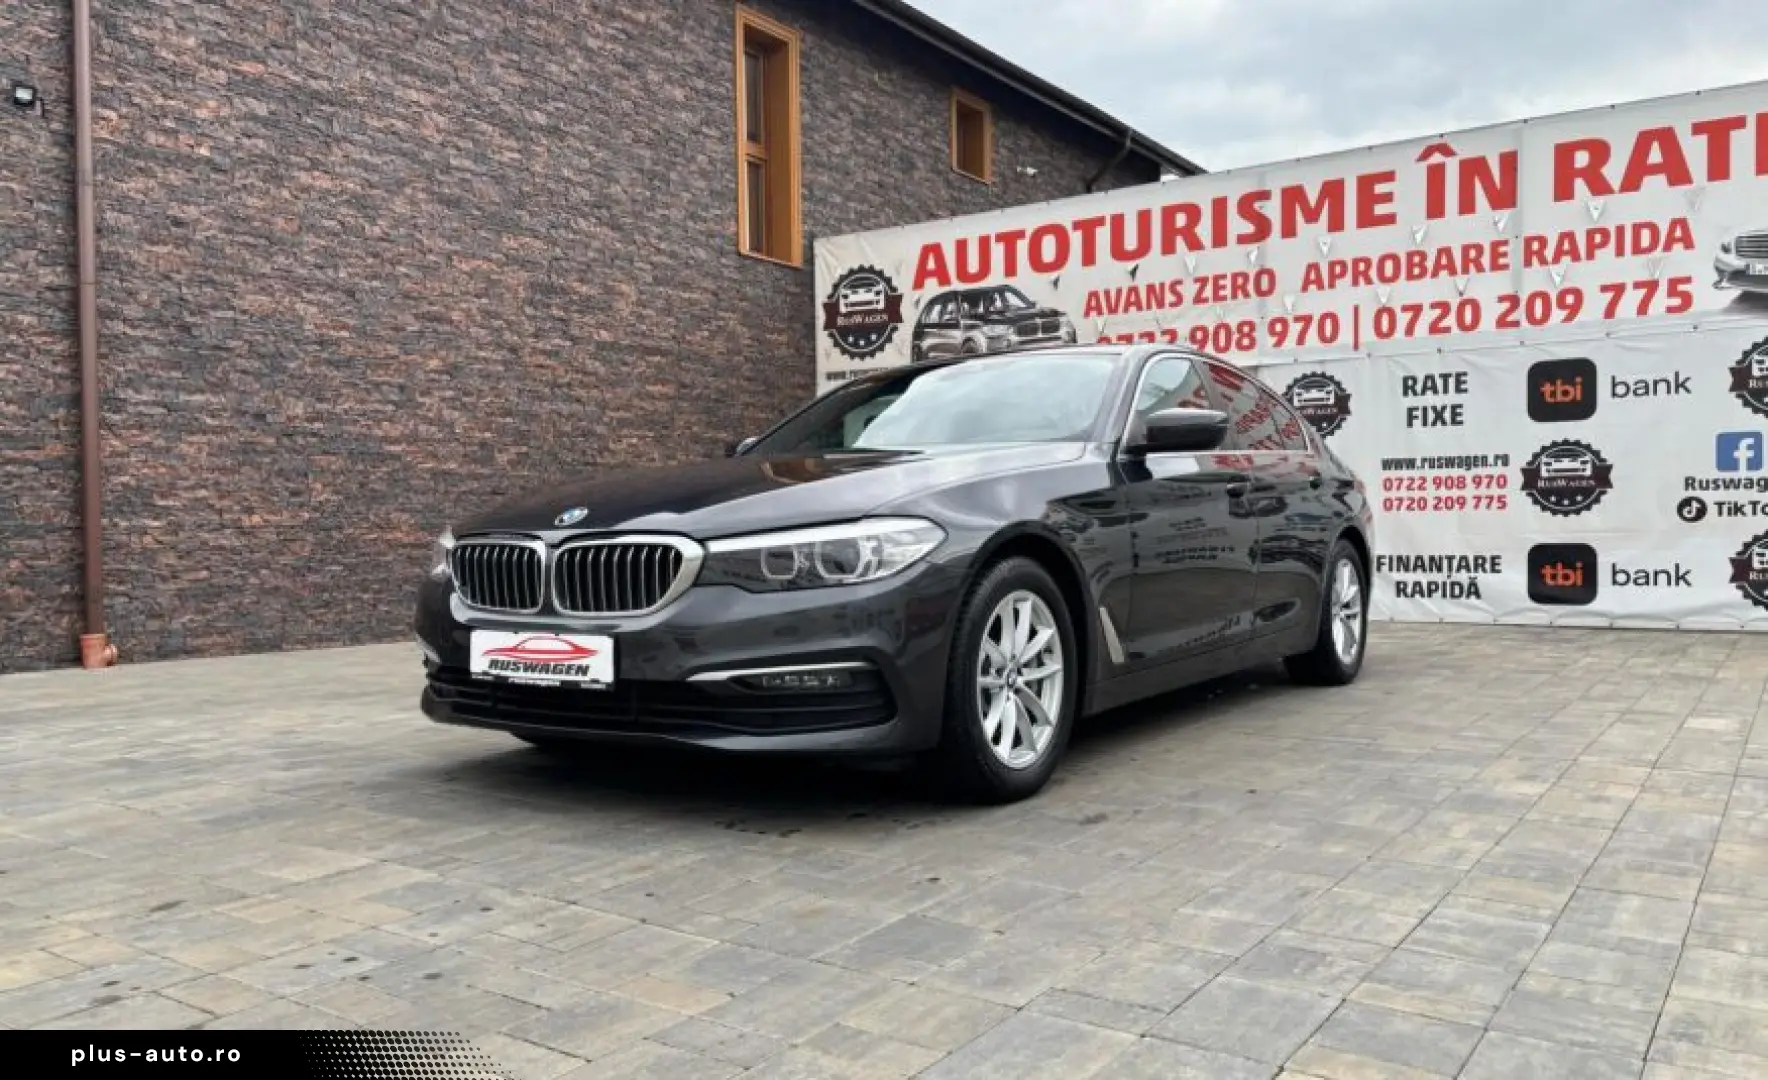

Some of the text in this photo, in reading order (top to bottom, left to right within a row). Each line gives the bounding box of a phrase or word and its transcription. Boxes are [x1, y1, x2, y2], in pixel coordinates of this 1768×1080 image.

[911, 171, 1398, 292] AUTOTURISME
[1417, 142, 1518, 221] ÎN
[1083, 217, 1695, 319] AVANS ZERO APROBARE RAPIDA
[1188, 319, 1258, 354] 908
[1267, 311, 1341, 348] 970
[1373, 297, 1482, 341] 0720
[1494, 286, 1585, 330] 209
[1599, 275, 1694, 320] 775
[1402, 371, 1469, 398] RATE
[1540, 371, 1692, 404] tbi bank
[1406, 403, 1464, 429] FIXE
[1382, 473, 1508, 492] 0722 908 970
[1382, 494, 1507, 512] 0720 209 775
[1394, 576, 1483, 600] RAPIDĂ
[1541, 562, 1692, 589] tbi bank
[487, 658, 590, 677] RUSWAGEN
